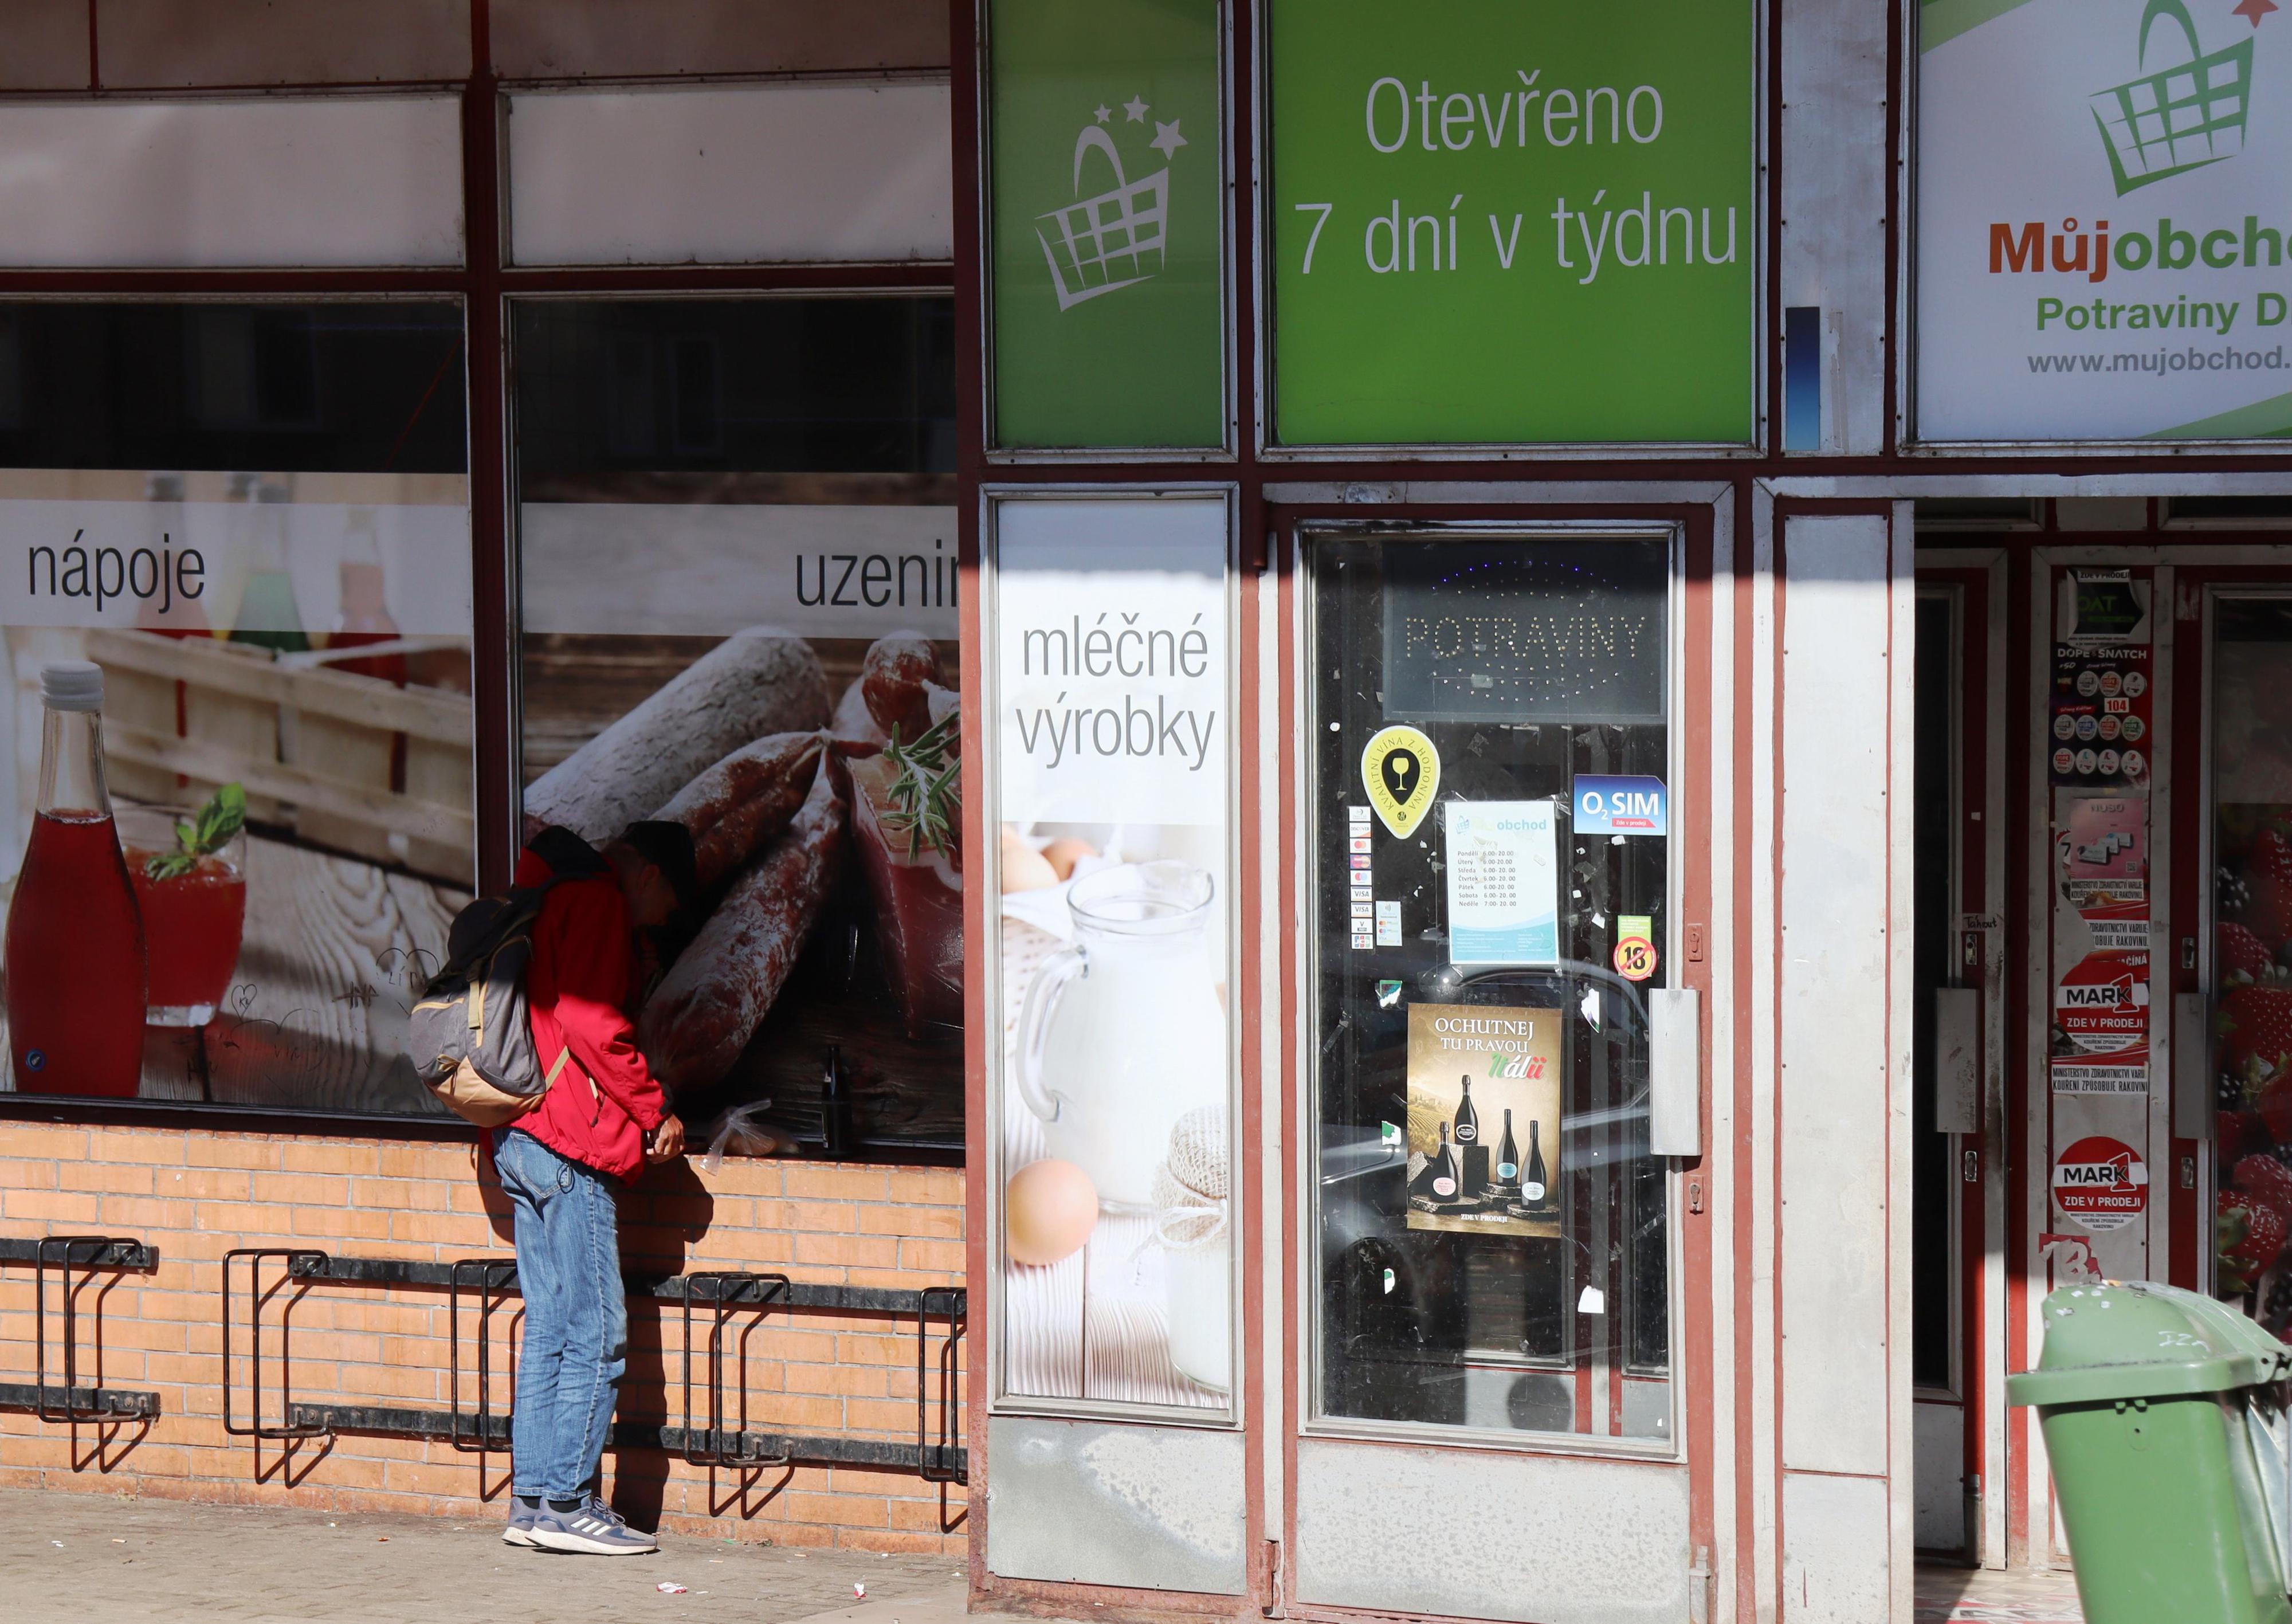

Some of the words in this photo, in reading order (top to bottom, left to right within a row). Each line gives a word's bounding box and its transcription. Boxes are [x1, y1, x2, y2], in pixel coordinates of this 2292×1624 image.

[1365, 69, 1664, 155] Otevřeno
[1295, 203, 1333, 274] 7
[1365, 194, 1459, 274] dní
[1489, 214, 1523, 270] v
[1552, 189, 1737, 285] týdnu
[2037, 295, 2239, 335] Potraviny
[2256, 293, 2292, 327] D
[28, 530, 205, 614] nápoje
[1023, 613, 1208, 678] mléčné
[2057, 648, 2090, 658] DOPE
[2098, 649, 2147, 659] SNATCH
[2107, 700, 2126, 711] 104
[1015, 692, 1215, 771] výrobky
[1377, 737, 1403, 753] VÍNA
[1371, 756, 1394, 810] KVALITNÍ
[1611, 793, 1658, 816] SIM
[1497, 819, 1547, 830] obchod
[1624, 946, 1646, 970] 18
[1434, 1017, 1534, 1041] OCHUTNEJ
[2066, 1018, 2087, 1027] ZDE
[2090, 1018, 2097, 1027] V
[2100, 1018, 2143, 1028] PRODEJI
[1441, 1037, 1462, 1050] TU
[1467, 1039, 1528, 1053] PRAVOU
[2053, 1068, 2089, 1078] MINISTERSTVO
[2065, 1197, 2085, 1206] ZDE
[2087, 1197, 2094, 1206] V
[2098, 1197, 2140, 1207] PRODEJI
[1481, 1214, 1508, 1222] PRODEJI
